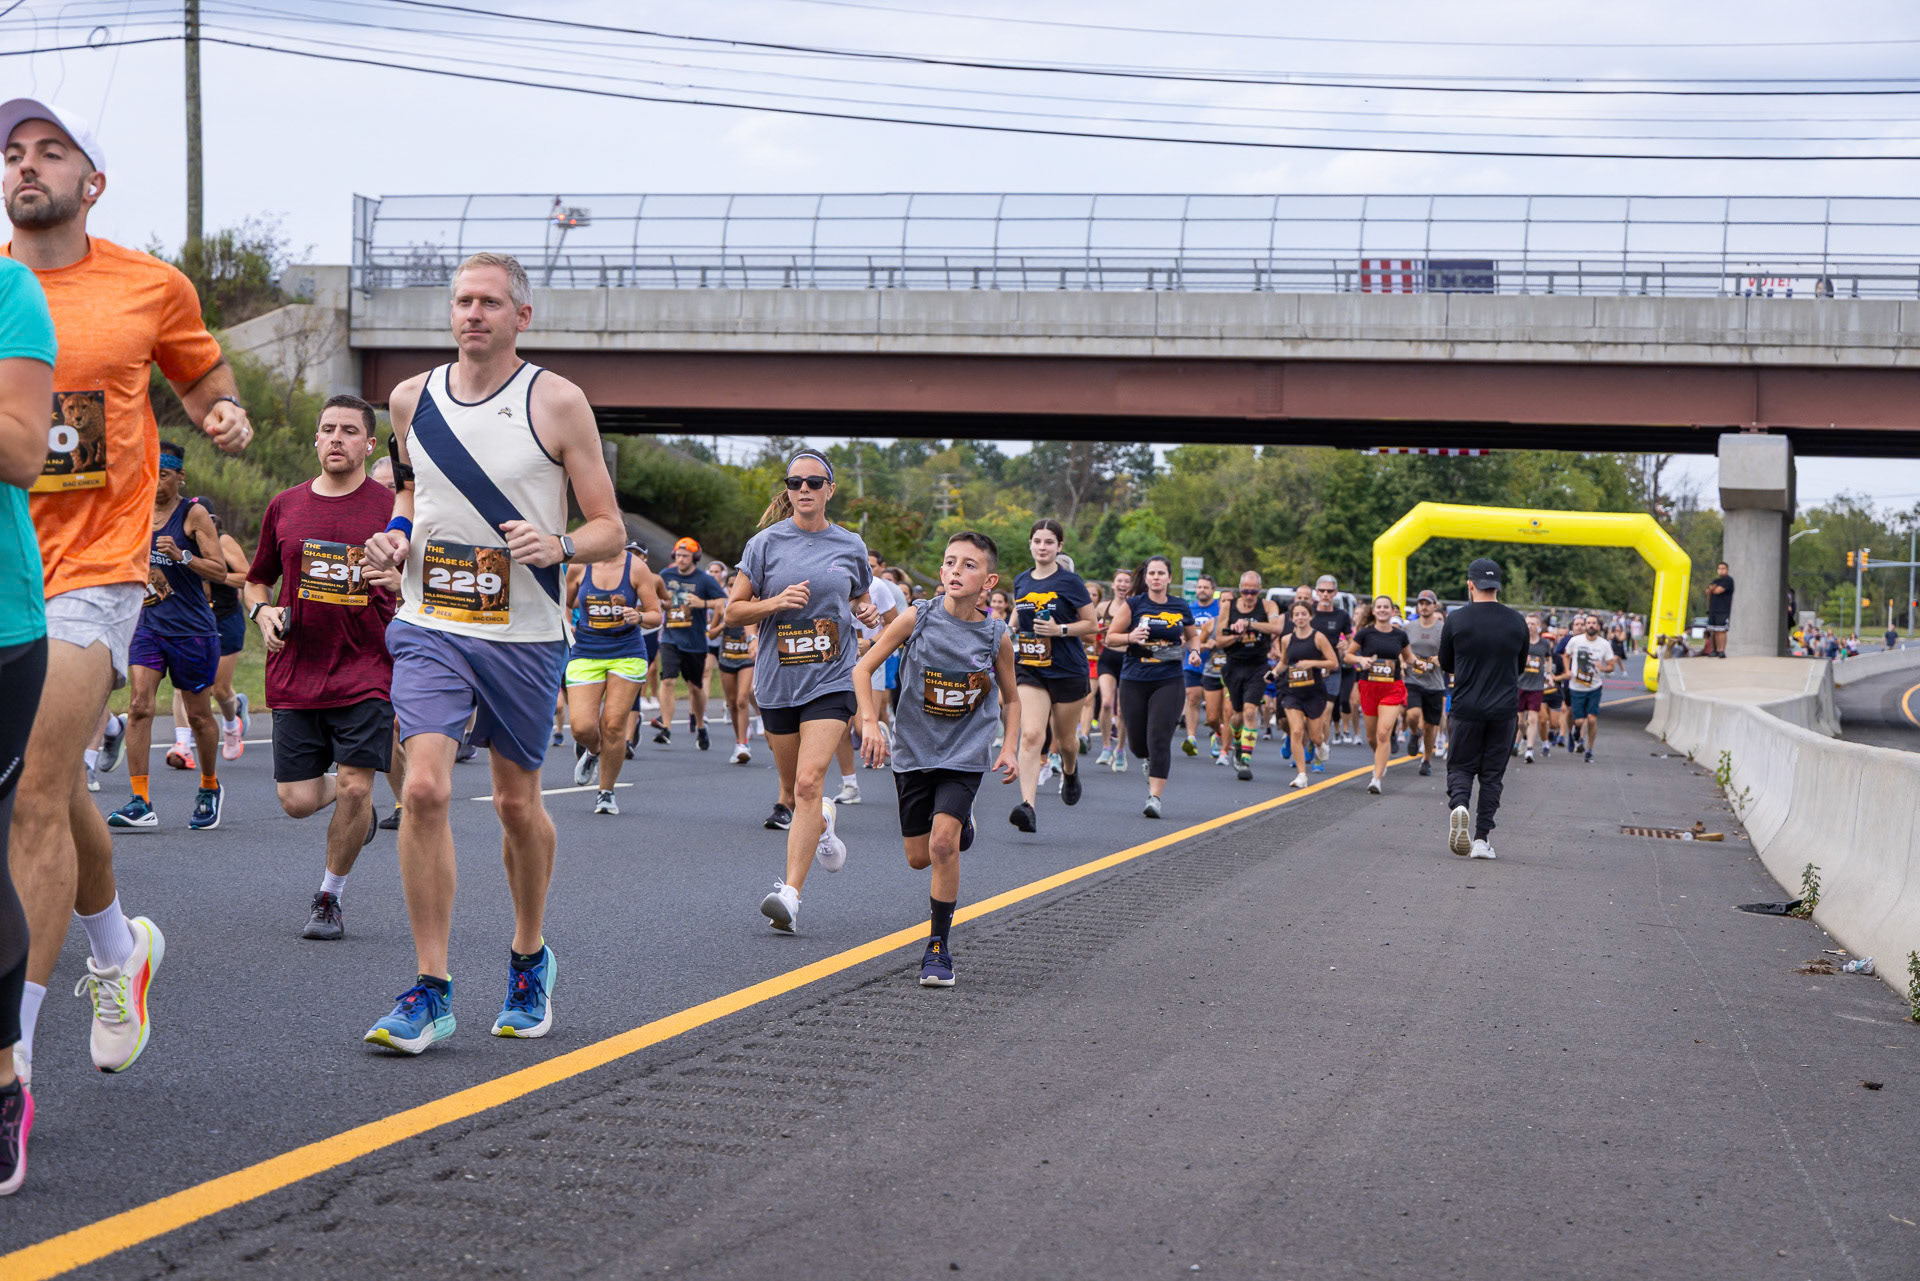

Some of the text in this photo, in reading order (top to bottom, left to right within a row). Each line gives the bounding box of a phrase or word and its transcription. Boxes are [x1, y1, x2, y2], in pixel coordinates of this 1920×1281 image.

[305, 542, 321, 550] THE
[427, 545, 445, 554] THE
[303, 550, 332, 560] CHASE
[425, 555, 475, 568] CHASE 5K
[310, 560, 362, 583] 231
[428, 567, 502, 595] 229
[436, 609, 453, 618] BEER
[588, 604, 623, 616] 206
[777, 629, 803, 637] CHASE
[784, 635, 831, 654] 128
[1021, 642, 1047, 655] 193
[926, 671, 943, 679] THE
[925, 678, 967, 689] CHASE 5K
[933, 687, 982, 707] 127
